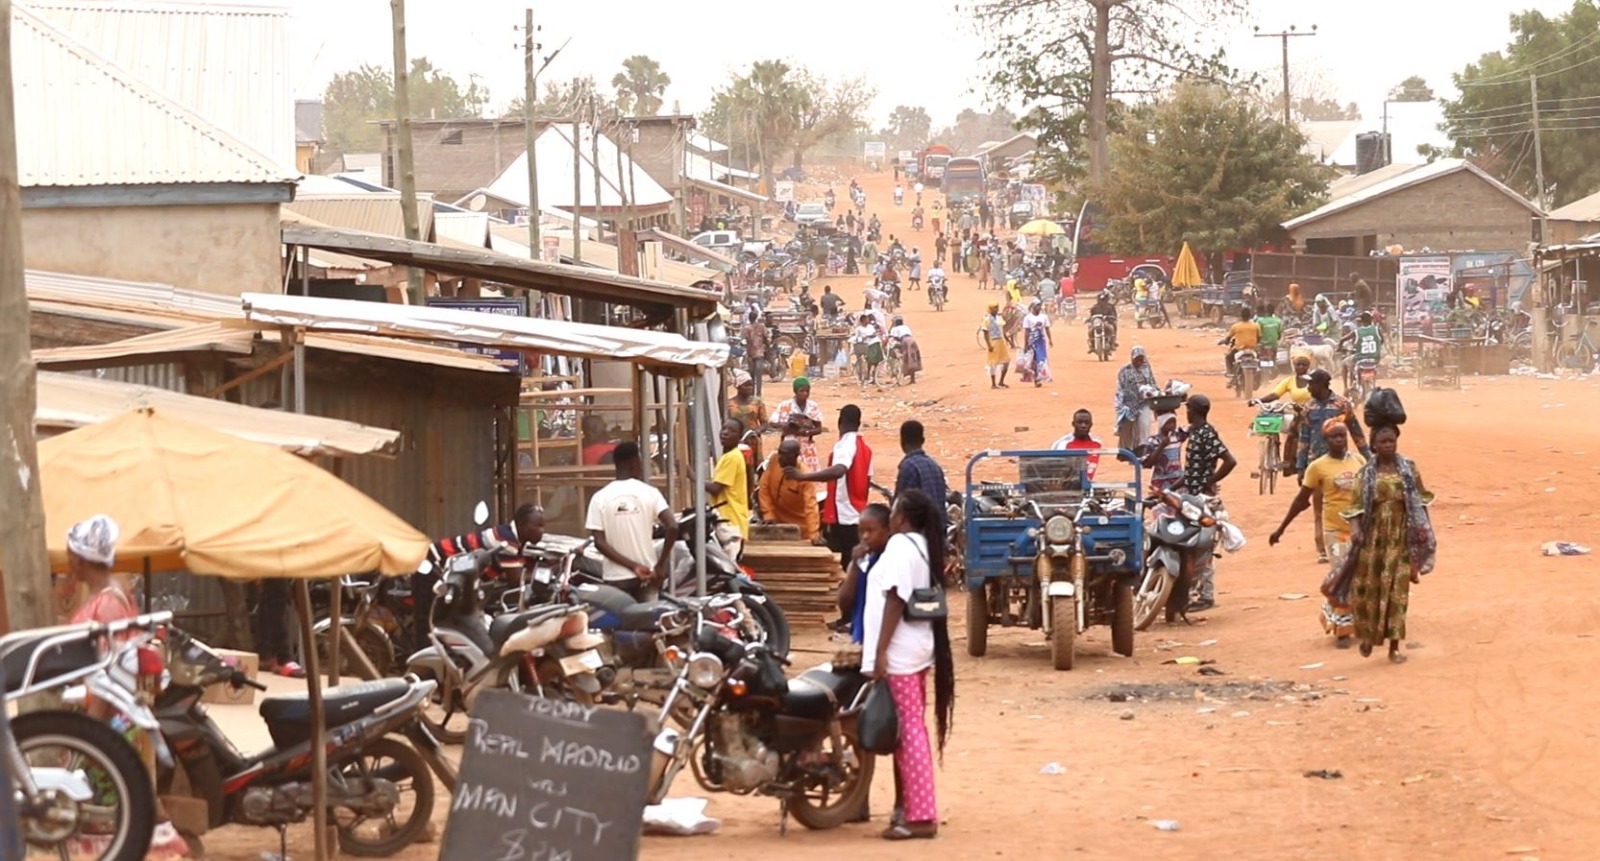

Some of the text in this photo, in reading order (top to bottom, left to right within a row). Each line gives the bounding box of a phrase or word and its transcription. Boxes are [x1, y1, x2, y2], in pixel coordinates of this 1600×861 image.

[1361, 340, 1377, 354] 20
[528, 700, 597, 721] TODAY
[471, 718, 640, 772] REAL MADRID
[452, 782, 612, 845] MAN CITY
